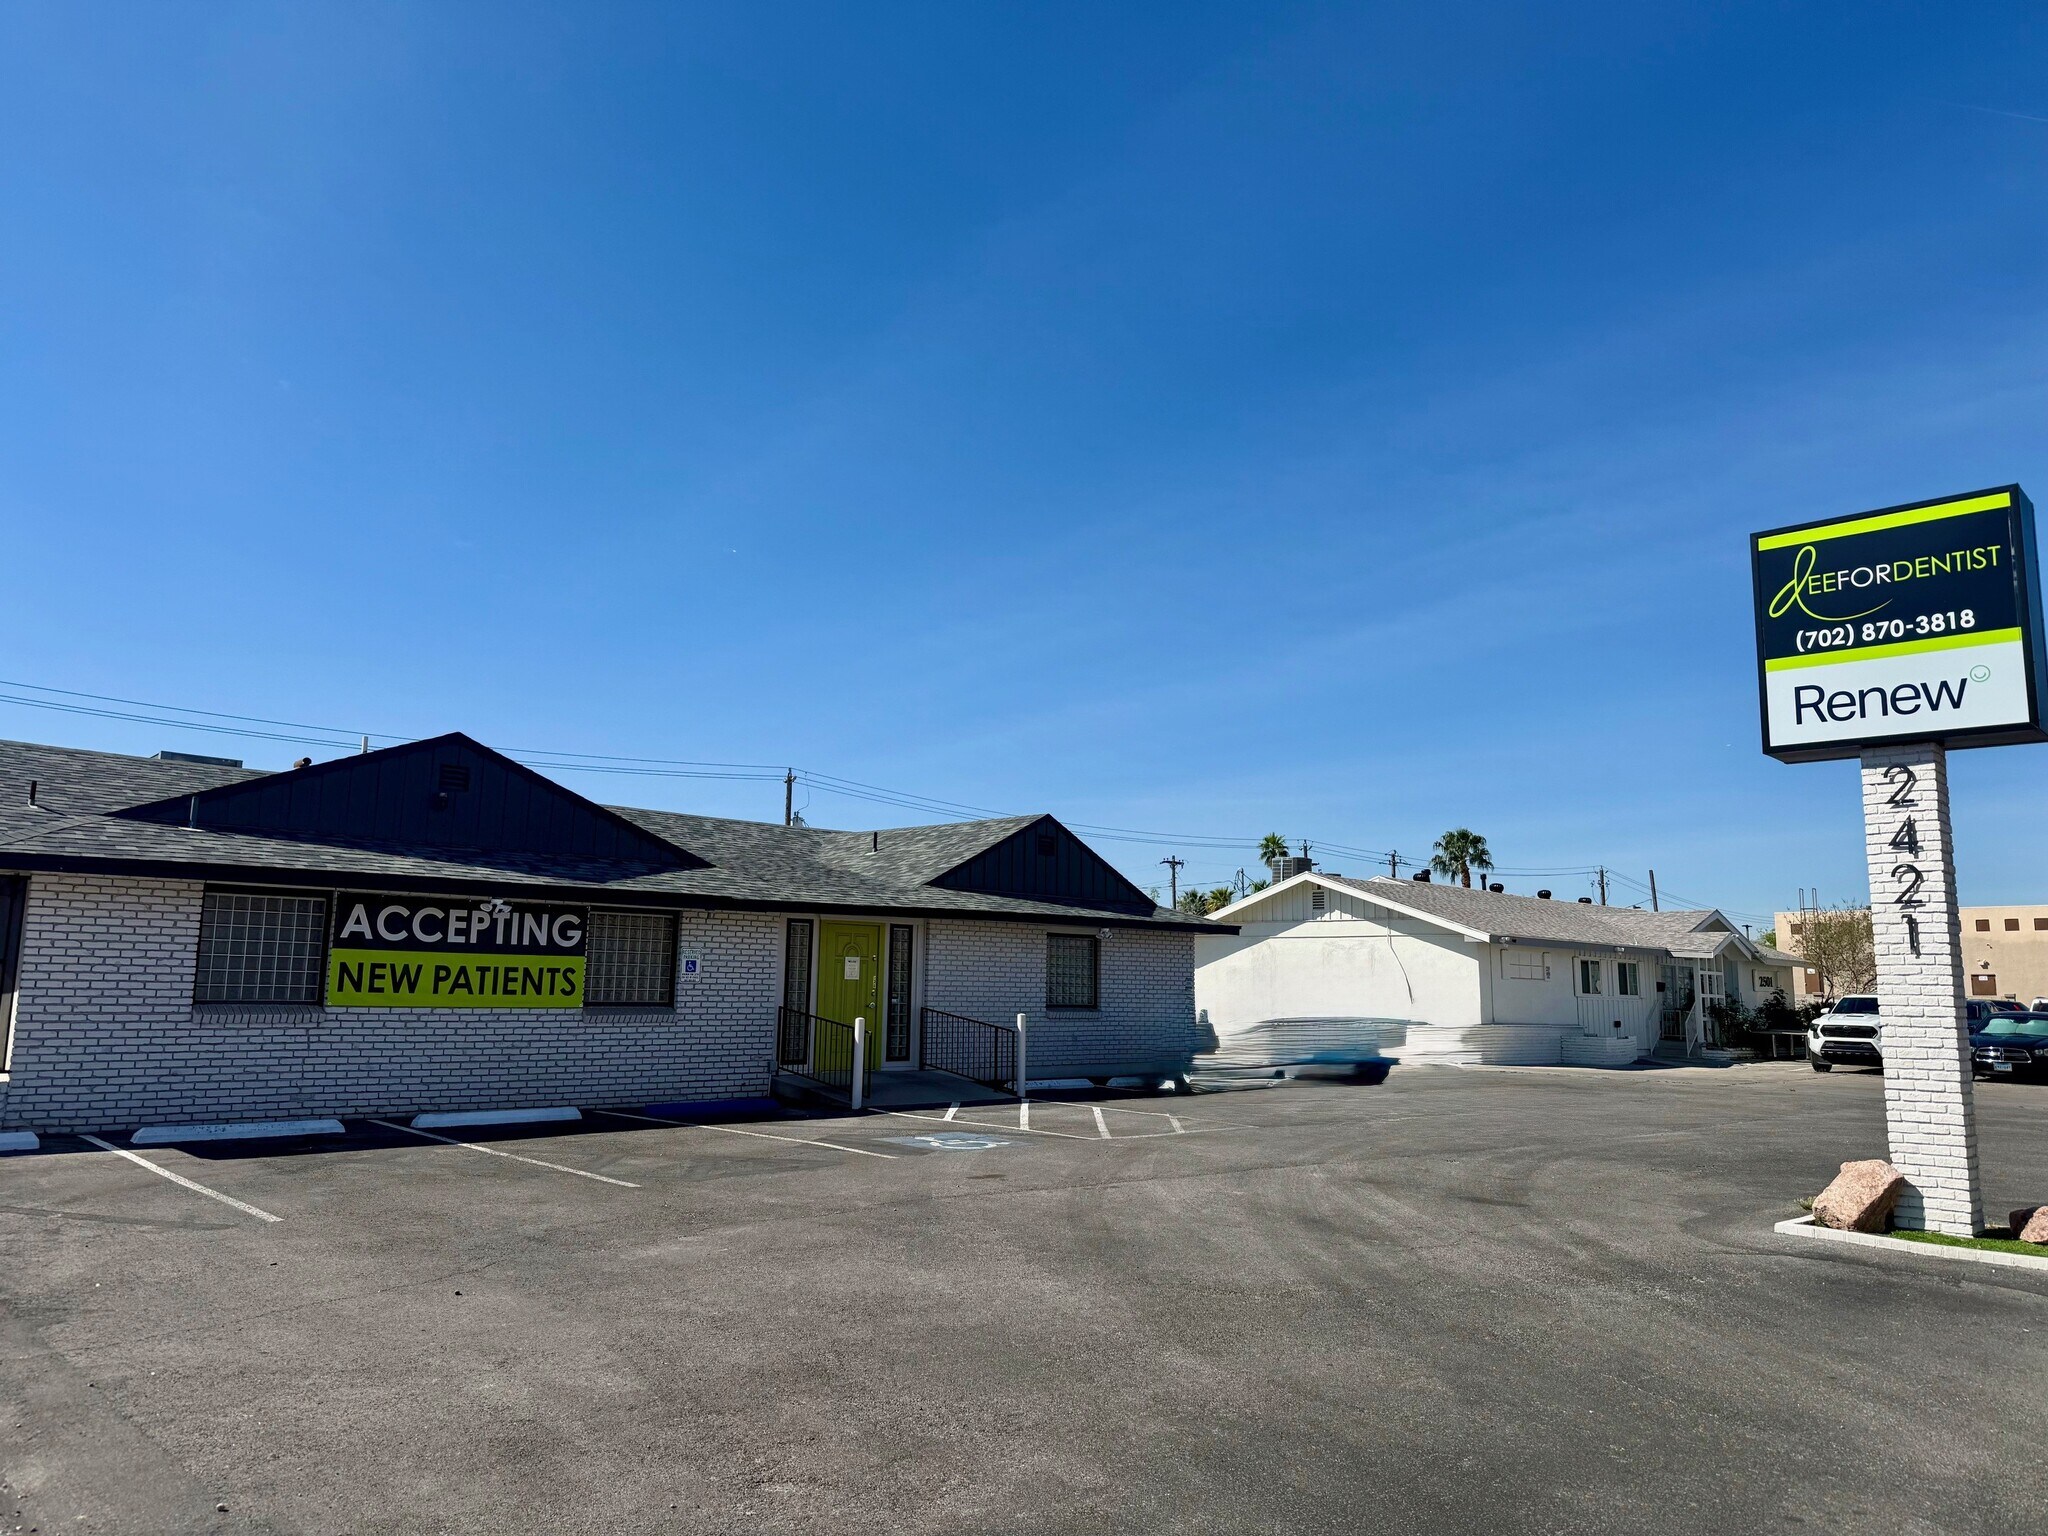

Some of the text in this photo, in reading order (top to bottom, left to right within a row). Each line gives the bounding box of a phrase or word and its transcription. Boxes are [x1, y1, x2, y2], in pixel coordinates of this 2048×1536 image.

[1796, 609, 1976, 652] (702) 870-3818
[1794, 678, 1967, 725] Renew
[1884, 763, 1923, 955] 2421
[340, 903, 582, 947] ACCEPTING
[336, 962, 576, 997] NEW PATIENTS
[1759, 976, 1773, 987] 2501
